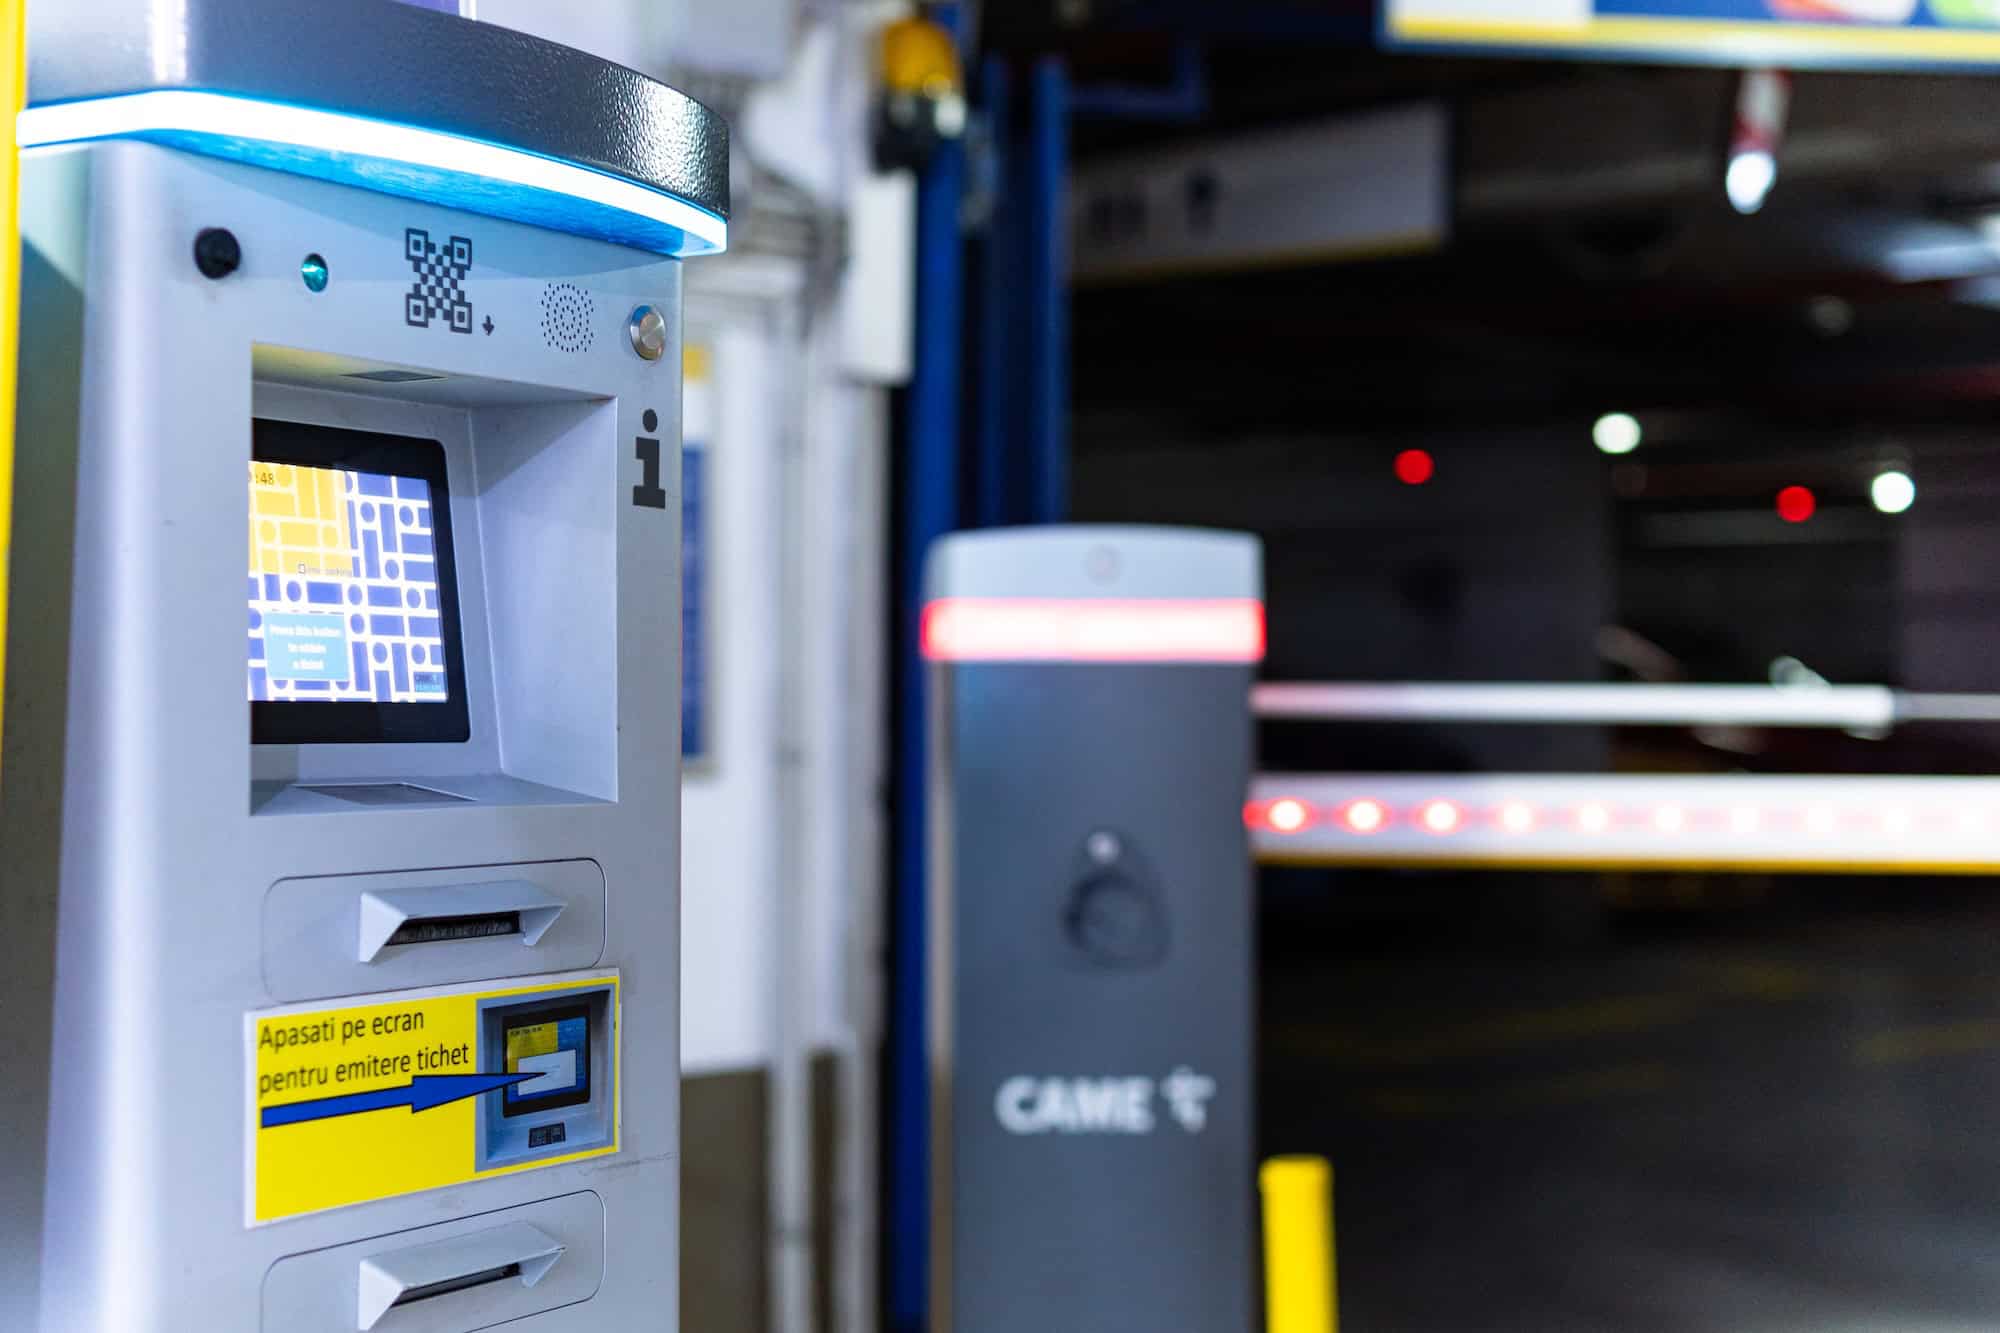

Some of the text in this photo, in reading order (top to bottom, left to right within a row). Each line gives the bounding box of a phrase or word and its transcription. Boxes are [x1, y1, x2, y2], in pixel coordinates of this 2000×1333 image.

[259, 1008, 424, 1053] Apasati pe ecran
[259, 1042, 469, 1097] pentru emitere tichet
[995, 1075, 1156, 1134] CAME
